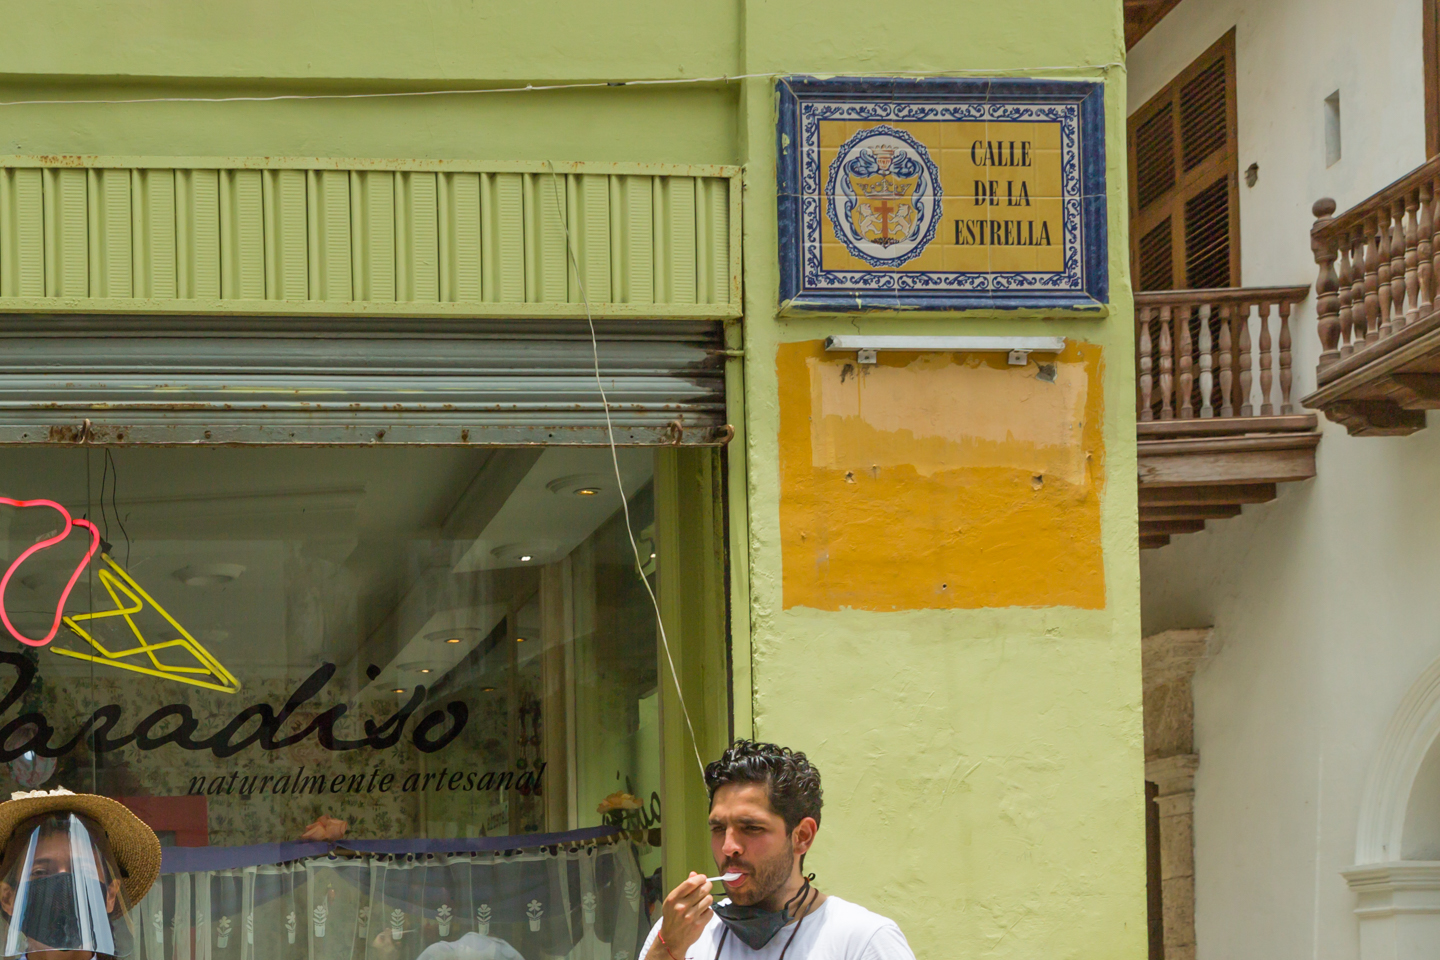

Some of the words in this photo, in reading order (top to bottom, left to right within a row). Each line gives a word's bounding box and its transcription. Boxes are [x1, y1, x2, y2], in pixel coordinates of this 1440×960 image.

[970, 140, 1032, 167] CALLE
[973, 180, 999, 206] DE
[1007, 180, 1031, 206] LA
[954, 219, 1052, 246] ESTRELLA
[187, 765, 395, 796] naturalmente
[402, 762, 548, 792] artesanal
